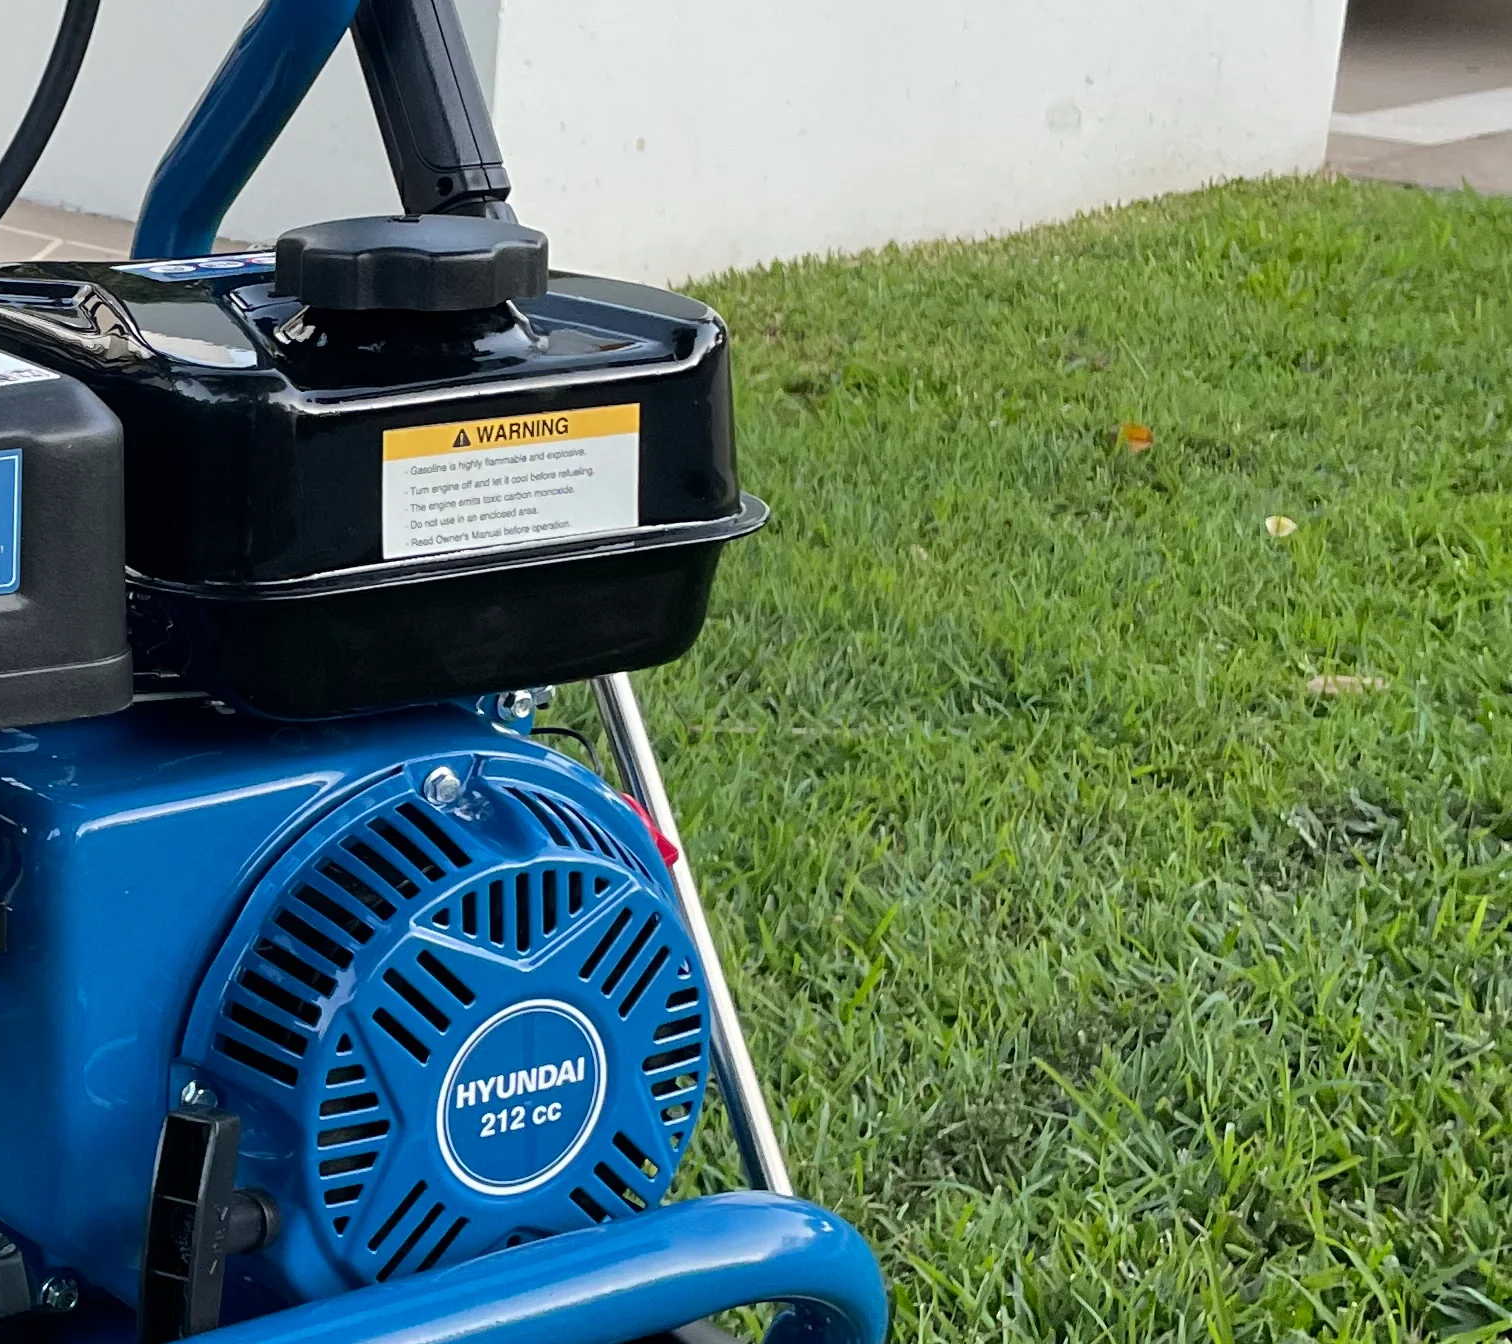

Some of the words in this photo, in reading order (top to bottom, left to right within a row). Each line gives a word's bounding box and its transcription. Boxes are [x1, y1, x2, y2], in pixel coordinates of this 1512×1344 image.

[476, 417, 569, 443] WARNING
[410, 464, 447, 476] Gasoline
[449, 462, 456, 471] is
[458, 459, 483, 471] highly
[484, 454, 527, 467] flammable
[529, 452, 545, 462] and
[410, 486, 430, 496] Turn
[431, 483, 459, 494] engine
[461, 479, 473, 490] off
[474, 478, 490, 488] and
[492, 477, 502, 486] let
[511, 474, 529, 484] cool
[530, 471, 557, 482] before
[410, 503, 427, 513] The
[428, 500, 457, 512] engine
[482, 494, 502, 504] toxic
[504, 491, 532, 502] carbon
[410, 520, 423, 530] Do
[424, 518, 438, 528] not
[440, 517, 455, 526] use
[457, 514, 465, 523] in
[467, 514, 478, 523] an
[479, 508, 517, 521] enclosed
[411, 537, 434, 547] Read
[435, 532, 469, 545] Owner's
[471, 527, 501, 539] Manual
[503, 525, 530, 536] before
[455, 1056, 586, 1109] HYUNDAI
[479, 1106, 526, 1138] 212
